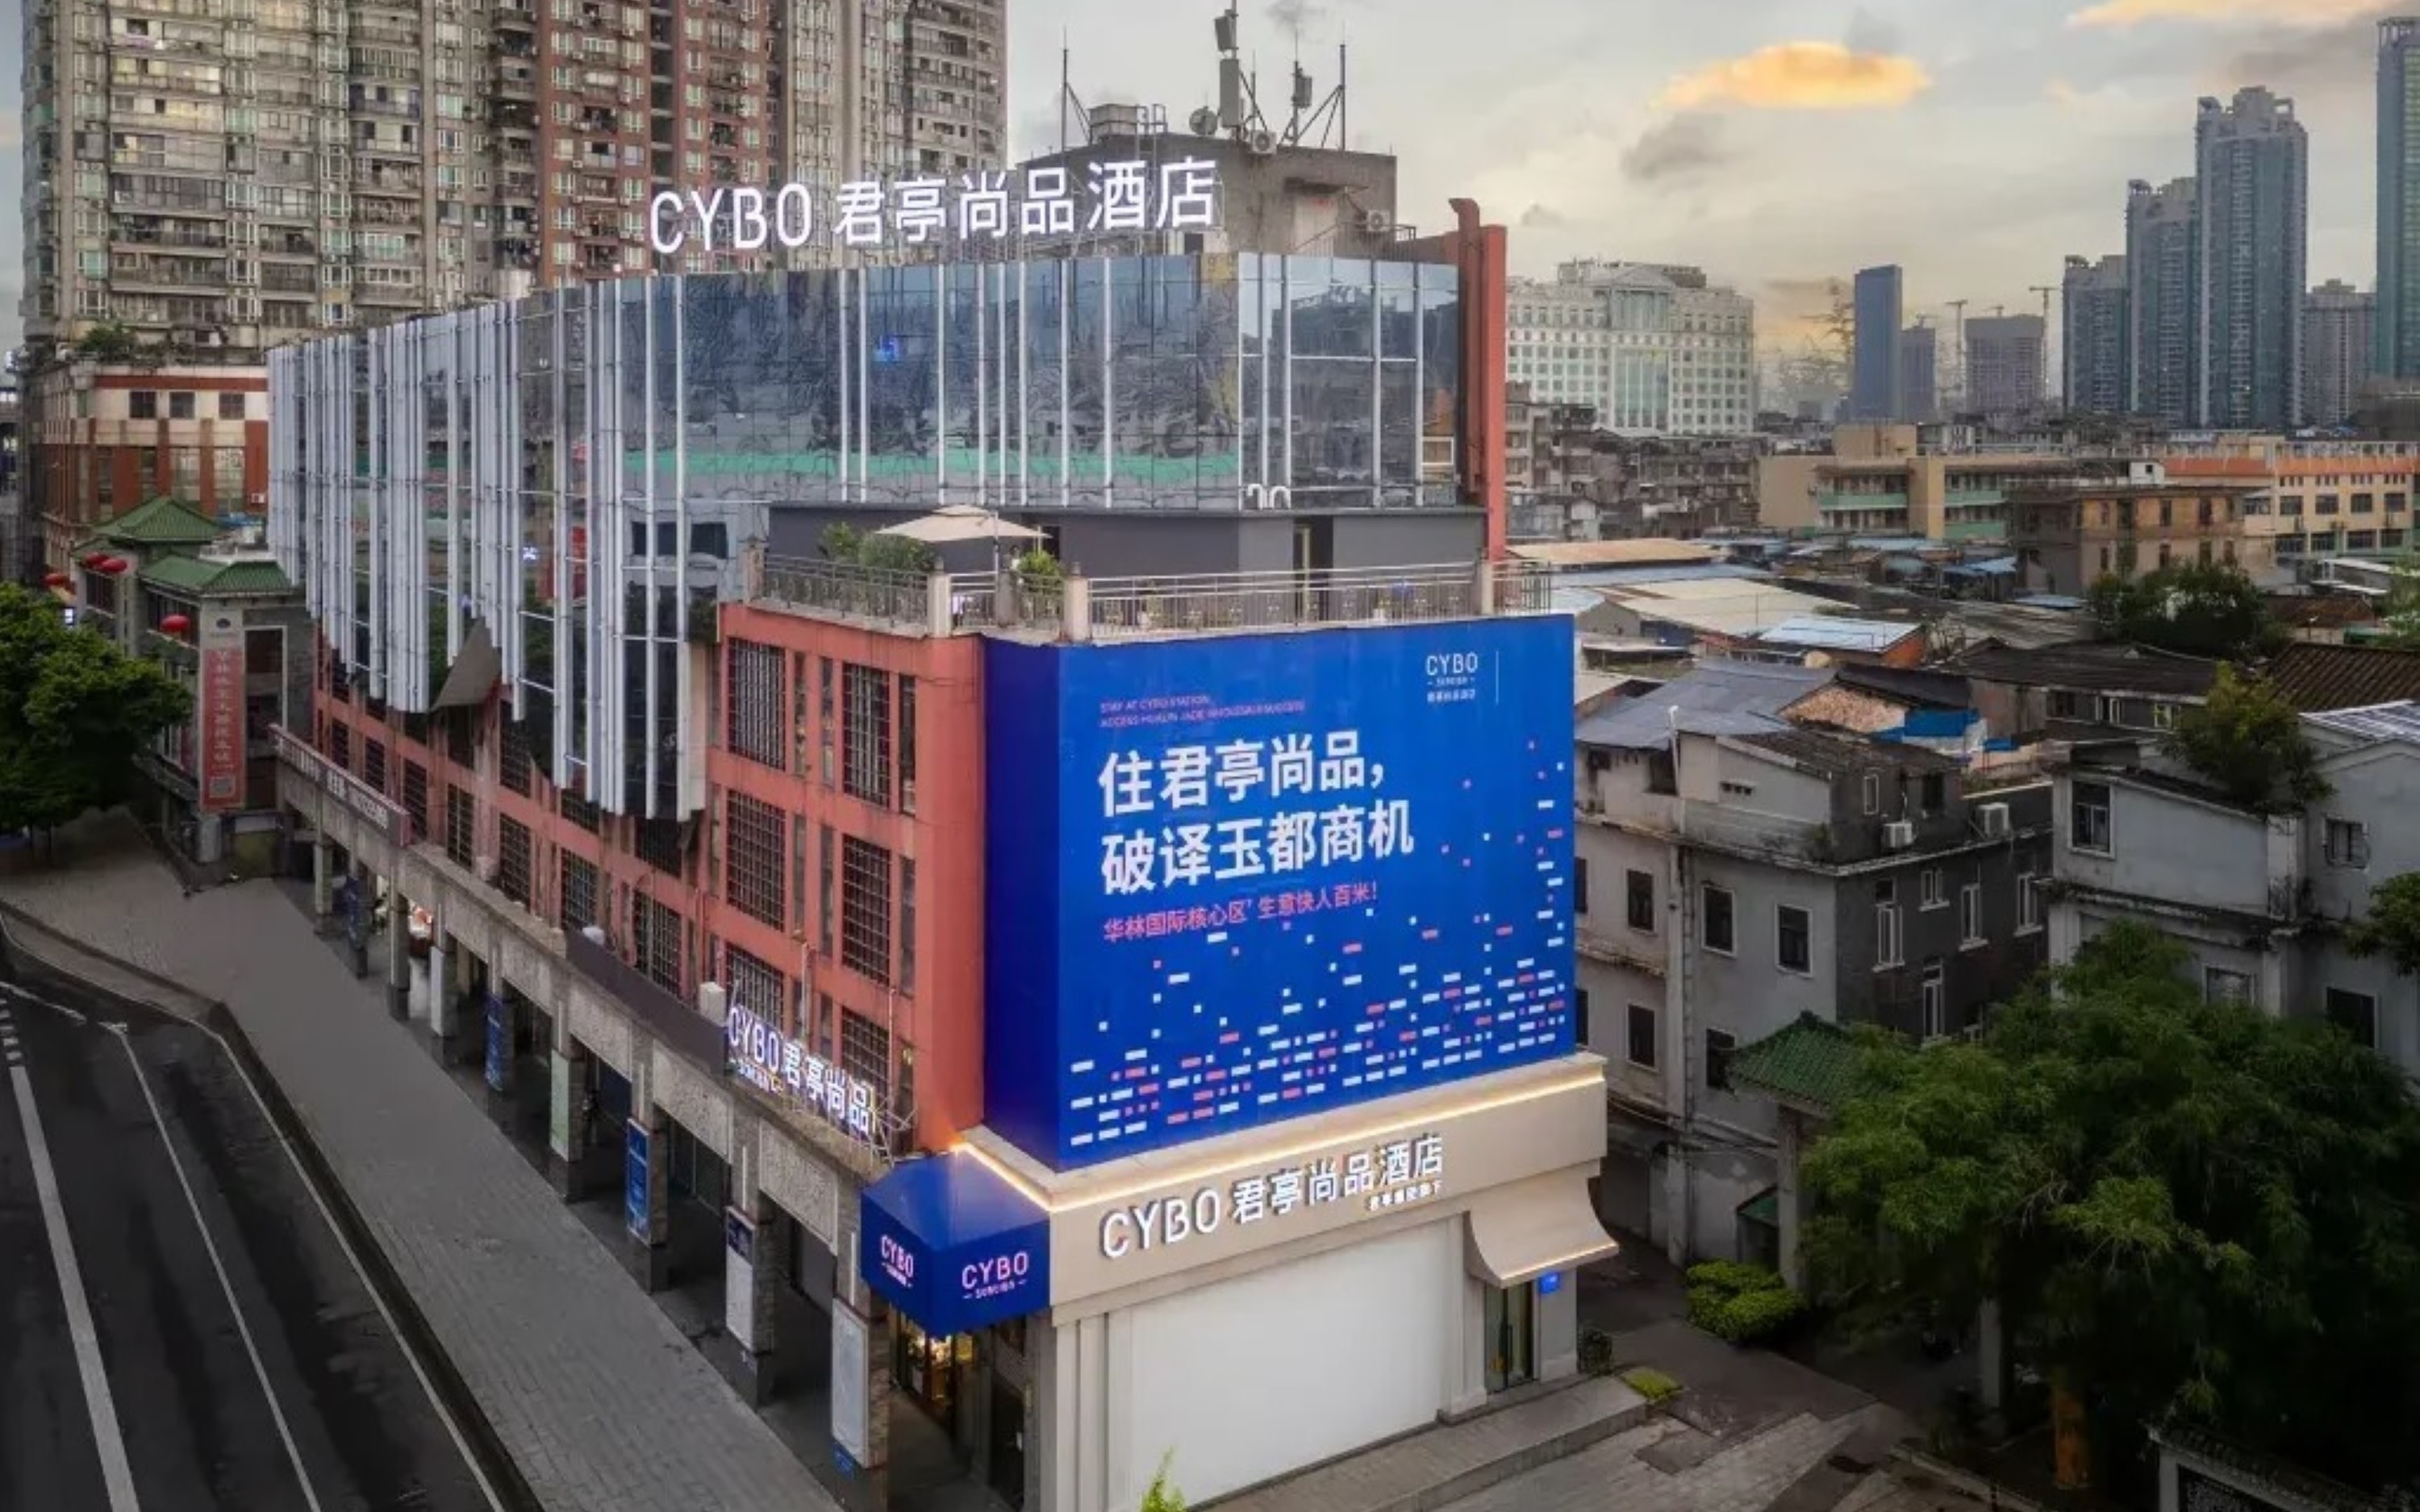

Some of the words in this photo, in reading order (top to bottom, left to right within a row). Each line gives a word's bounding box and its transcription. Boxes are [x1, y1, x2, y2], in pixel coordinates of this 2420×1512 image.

[650, 182, 813, 253] CYBO
[834, 156, 1216, 243] 君亭尚品酒店
[1426, 652, 1478, 676] CYBO
[1101, 799, 1414, 895] 破译玉都商机
[728, 1006, 779, 1073] CYBO
[782, 1039, 870, 1135] 君亭尚品
[1101, 1189, 1221, 1259] CYBO
[1232, 1134, 1442, 1224] 君亭尚品酒店
[881, 1234, 914, 1278] CYBO
[962, 1251, 1028, 1290] CYBO
